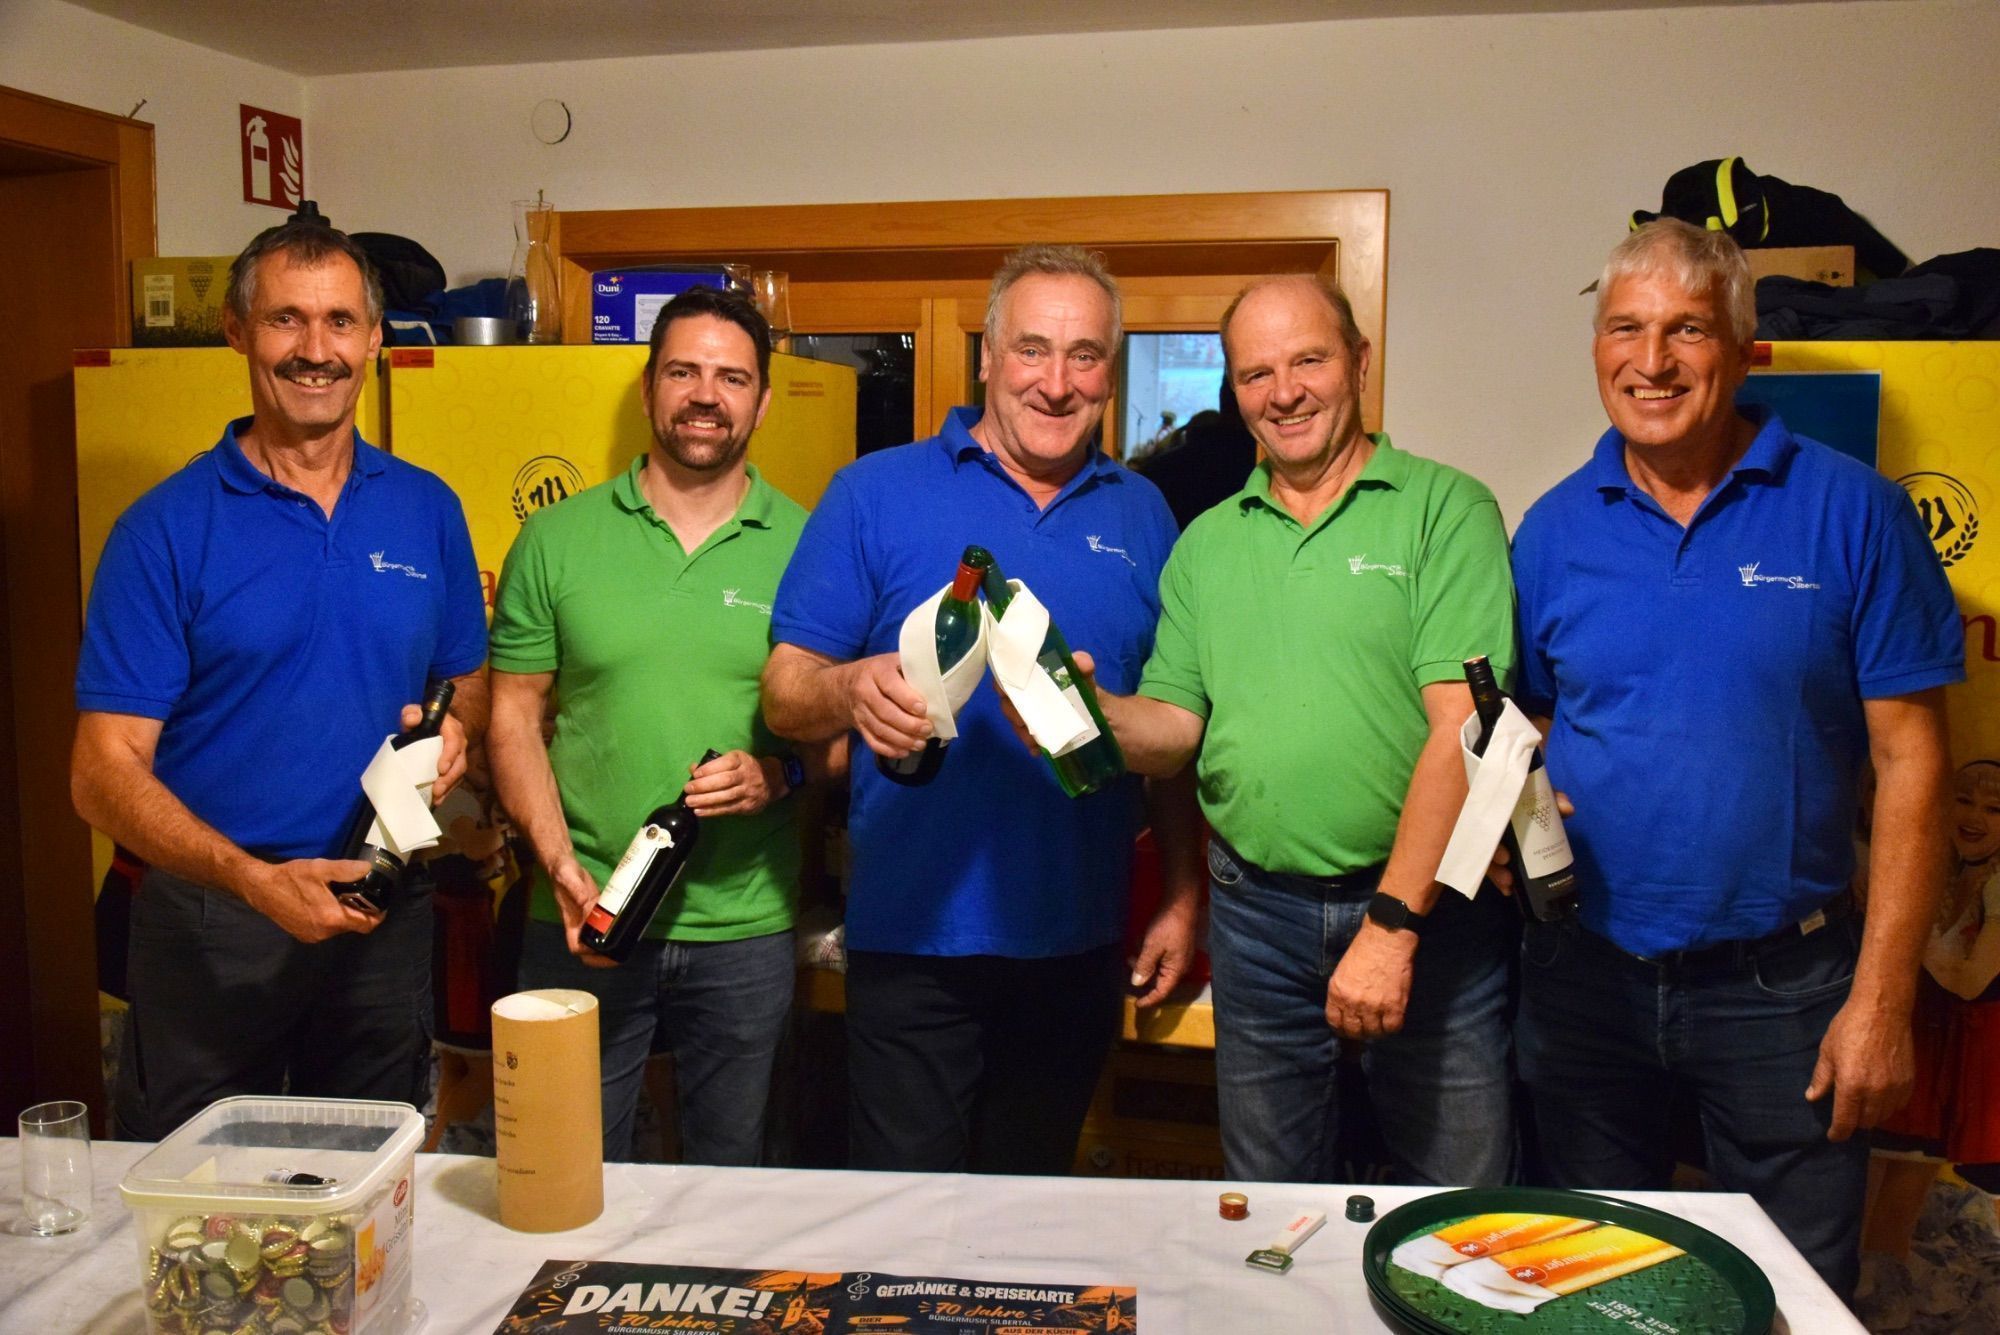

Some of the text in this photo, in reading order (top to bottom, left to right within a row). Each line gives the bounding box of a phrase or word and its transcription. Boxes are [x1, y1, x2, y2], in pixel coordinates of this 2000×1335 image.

[598, 283, 620, 293] Duni
[594, 315, 610, 324] 120
[876, 1281, 1075, 1305] GETRÄNKE & SPEISEKARTE
[562, 1283, 775, 1321] DANKE!
[1586, 1301, 1625, 1319] Bier
[935, 1302, 1028, 1320] 70 Jahre
[1606, 1300, 1680, 1334] seit 1881
[619, 1314, 718, 1330] 70 Jahre
[928, 1314, 1033, 1327] BÜRGERMUSIK SILBERTAL
[607, 1325, 671, 1335] BÜRGERMUSIK
